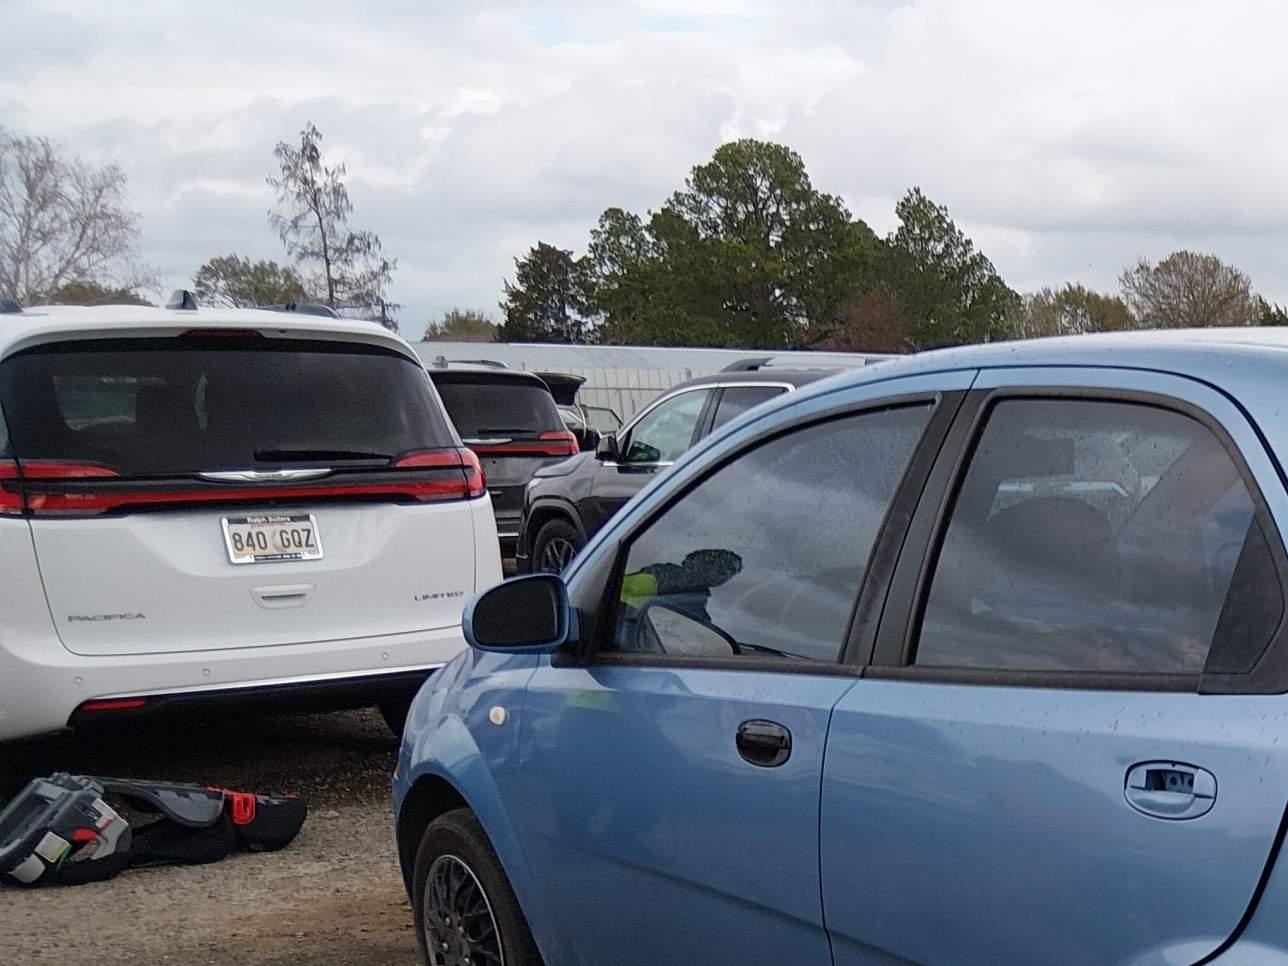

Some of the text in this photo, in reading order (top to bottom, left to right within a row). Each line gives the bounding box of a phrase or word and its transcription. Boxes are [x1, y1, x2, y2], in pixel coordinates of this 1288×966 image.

[232, 528, 315, 552] 840 GQZ
[414, 591, 465, 602] LIMITED
[67, 612, 146, 623] PACIFICA
